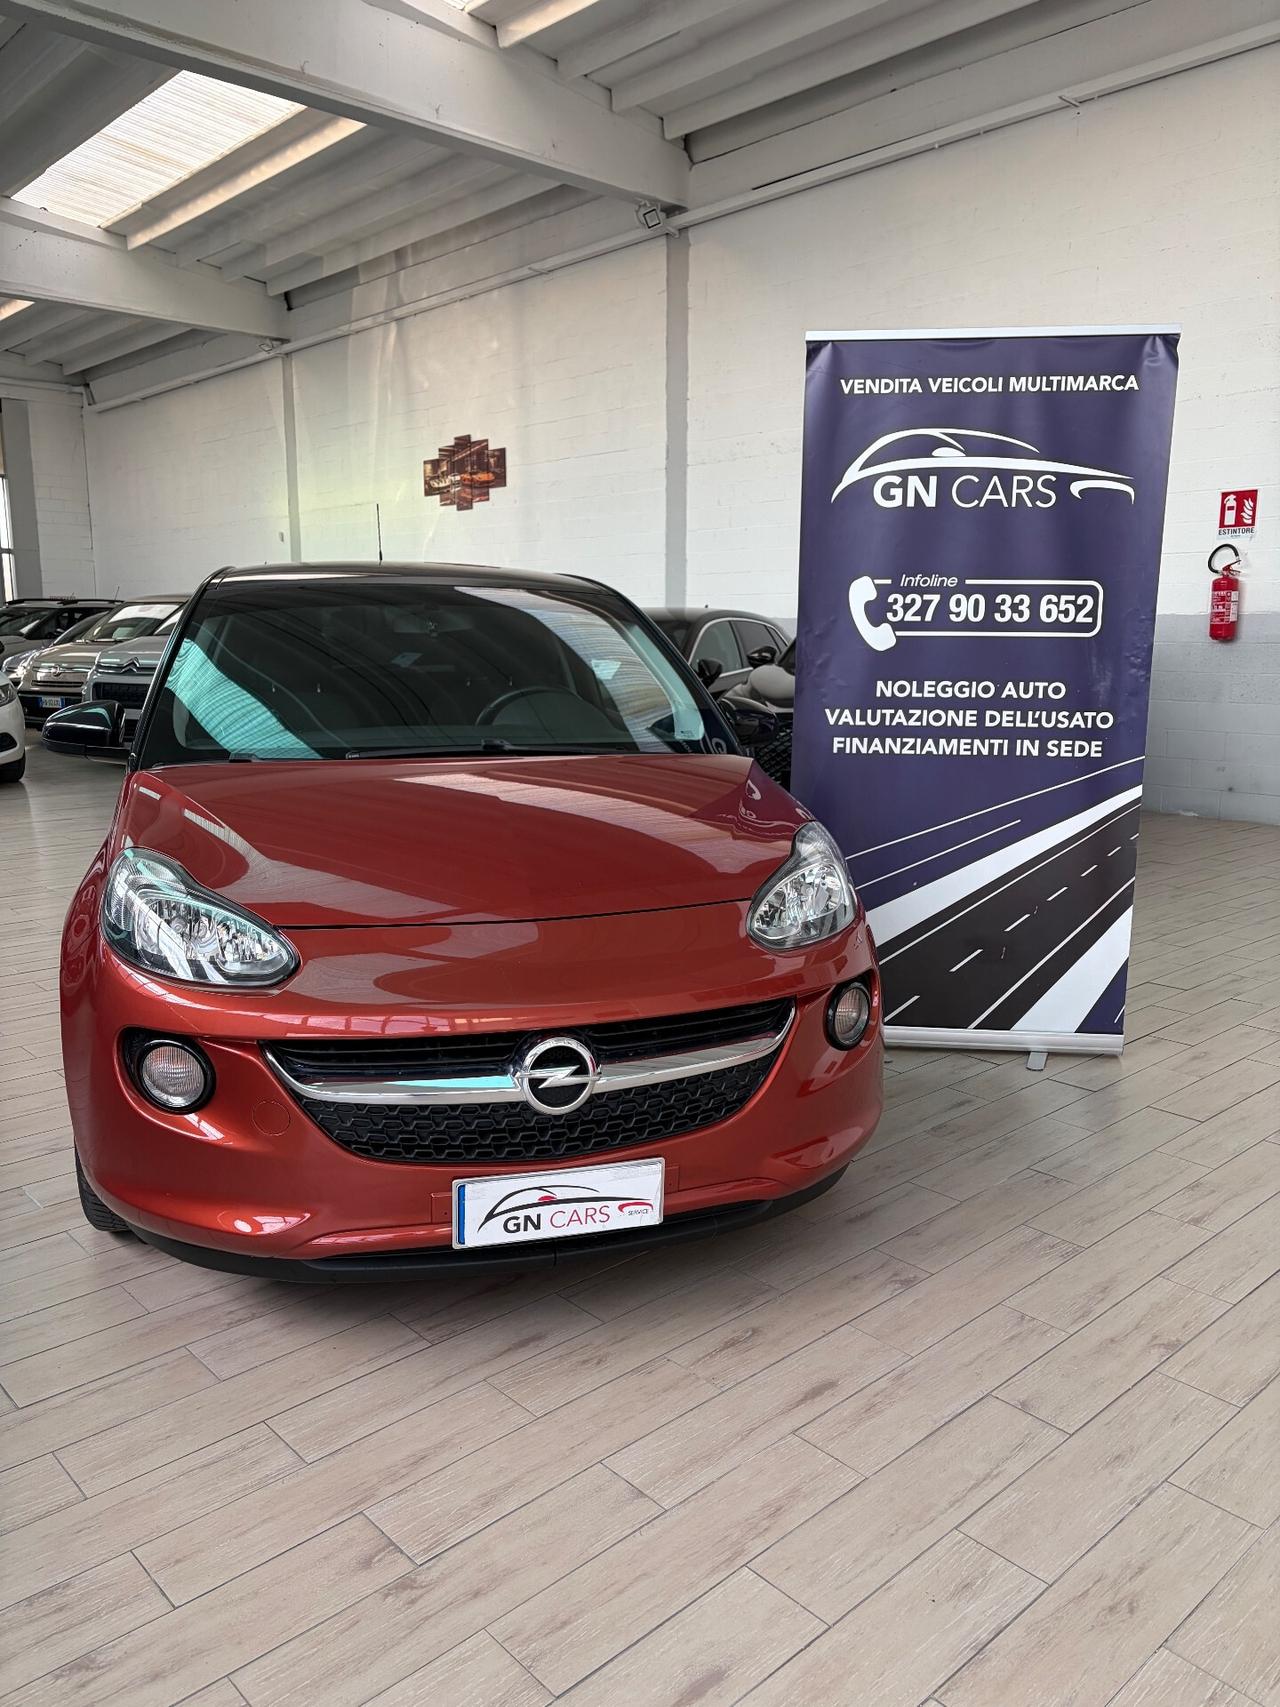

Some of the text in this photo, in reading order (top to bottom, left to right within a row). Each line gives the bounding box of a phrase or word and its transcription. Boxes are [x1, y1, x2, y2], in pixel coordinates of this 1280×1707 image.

[840, 375, 1140, 394] VENDITA VEICOLI MULTIMARCA
[873, 474, 1057, 508] GN CARS
[1218, 527, 1255, 535] ESTINTORE
[900, 574, 958, 587] Infoline
[886, 593, 1094, 623] 327 90 33 652
[875, 680, 1067, 700] NOLEGGIO AUTO
[824, 708, 1114, 729] VALUTAZIONE DELL'USATO
[832, 737, 1103, 758] FINANZIAMENTI IN SEDE
[503, 1205, 611, 1234] GN CARS
